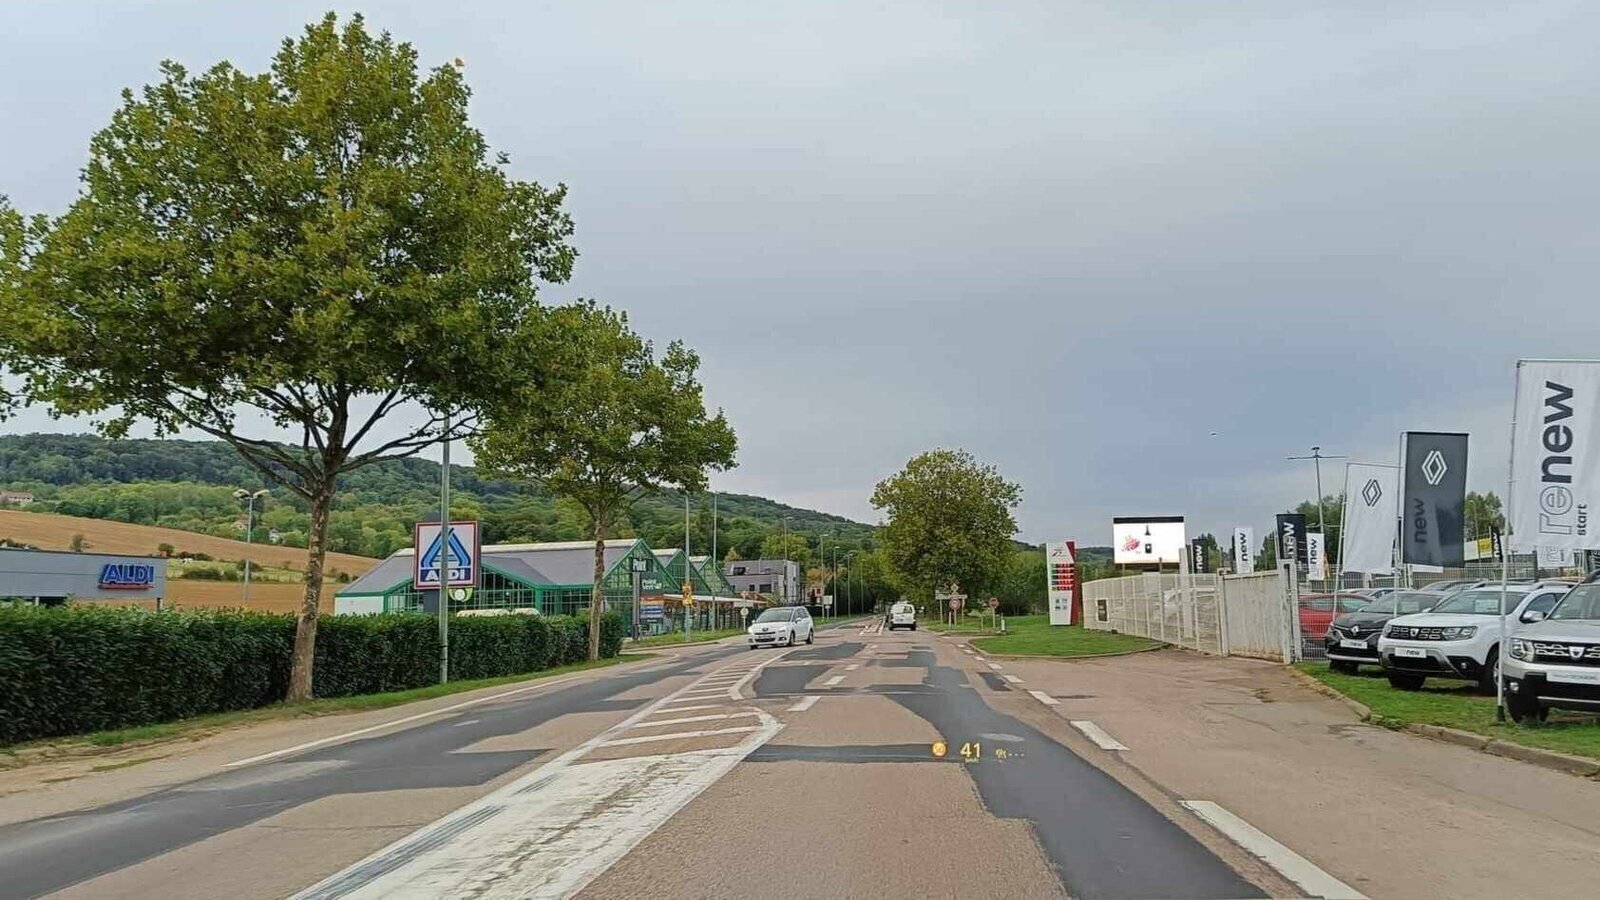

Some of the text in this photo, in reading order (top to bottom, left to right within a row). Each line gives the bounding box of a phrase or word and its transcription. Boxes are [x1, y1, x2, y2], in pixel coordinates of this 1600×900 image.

[1577, 504, 1587, 535] start
[102, 564, 155, 584] ALDI
[425, 569, 466, 581] ADI
[960, 743, 980, 758] 41
